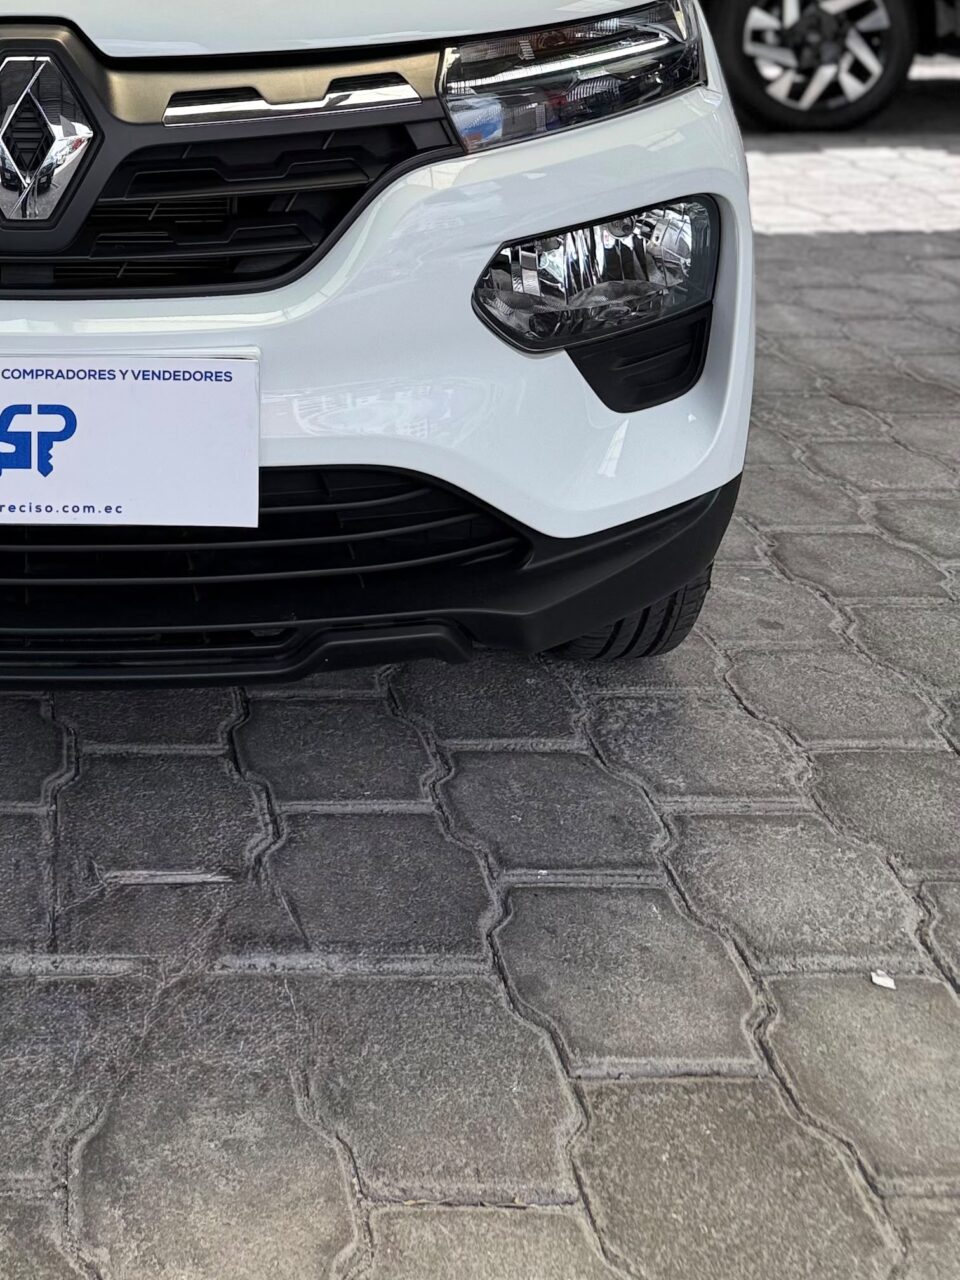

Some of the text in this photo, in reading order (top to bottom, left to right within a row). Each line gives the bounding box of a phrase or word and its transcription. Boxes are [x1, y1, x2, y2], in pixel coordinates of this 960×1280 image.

[0, 368, 117, 381] COMPRADORES
[118, 369, 130, 381] Y
[131, 370, 233, 383] VENDEDORES
